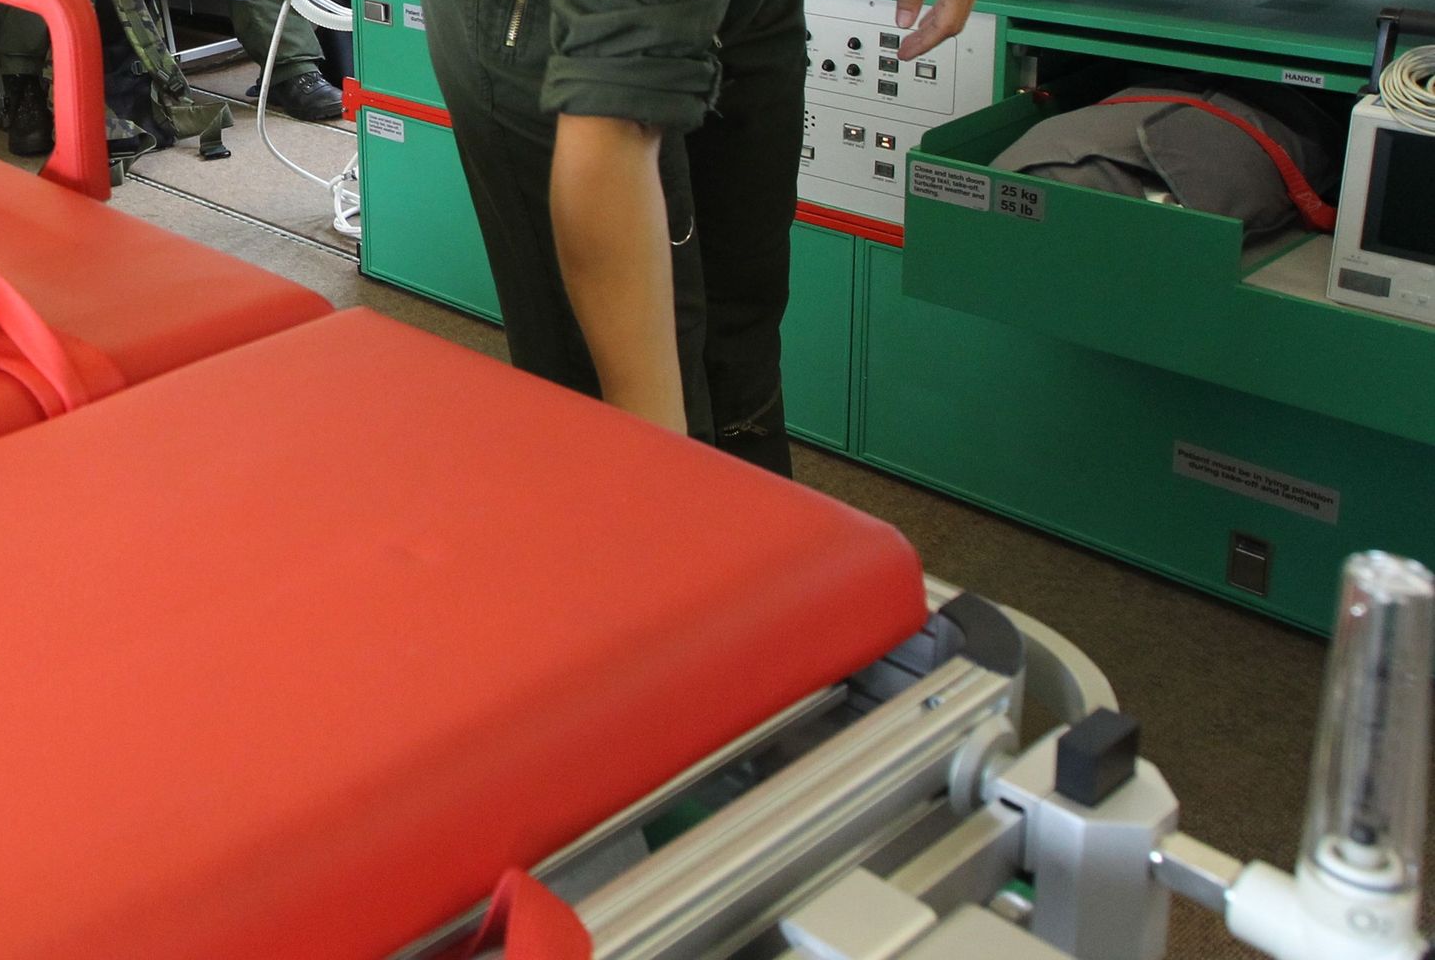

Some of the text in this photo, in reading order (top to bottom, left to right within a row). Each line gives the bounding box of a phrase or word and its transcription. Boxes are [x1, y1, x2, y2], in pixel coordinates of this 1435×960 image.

[1285, 72, 1322, 84] HANDLE
[914, 165, 933, 174] Close
[947, 172, 964, 181] latch
[965, 176, 985, 186] doors
[914, 172, 936, 183] during
[937, 177, 951, 186] taxi,
[914, 179, 985, 200] turbulent weather and
[1001, 184, 1038, 204] 25 kg
[1001, 200, 1033, 216] 55 lb
[1178, 448, 1334, 505] Patient must be in lying position
[1188, 461, 1320, 510] during take-off and landing
